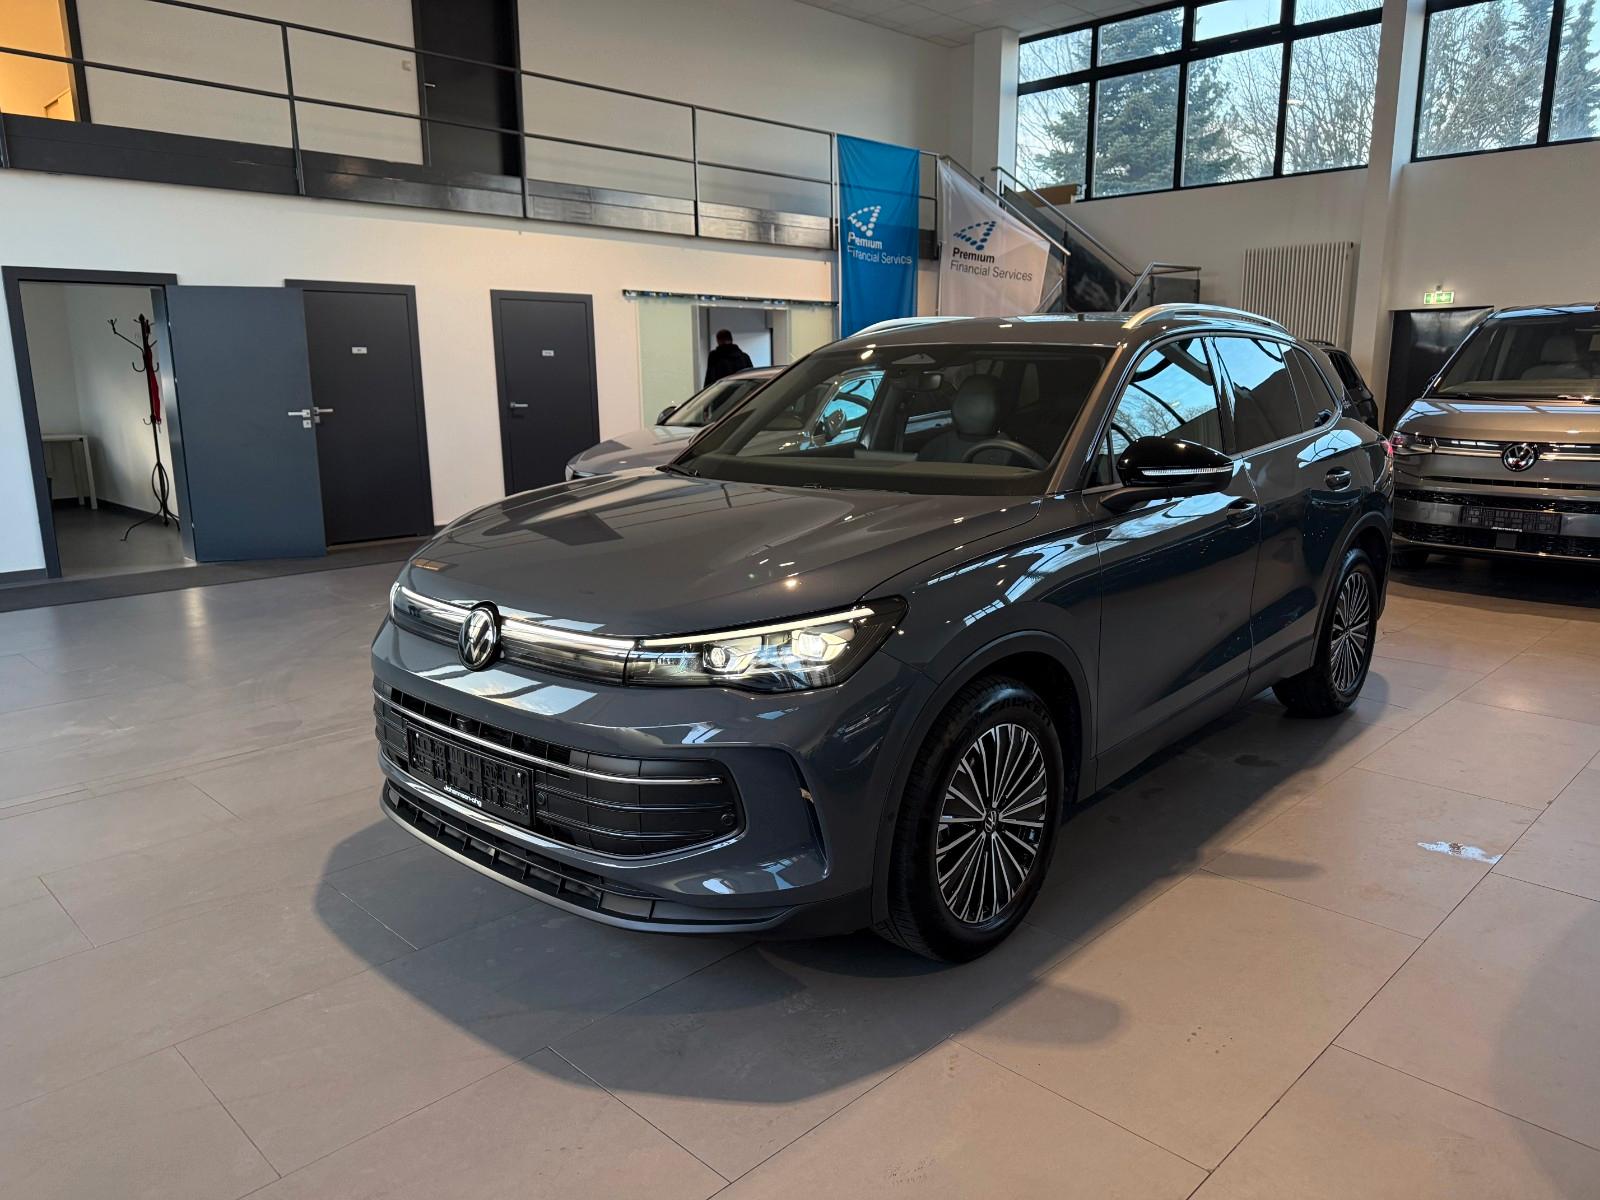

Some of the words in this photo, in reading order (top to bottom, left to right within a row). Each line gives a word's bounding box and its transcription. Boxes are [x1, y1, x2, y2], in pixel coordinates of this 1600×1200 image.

[848, 232, 882, 250] Pemium
[952, 247, 995, 263] Premium
[950, 260, 990, 276] Financial
[992, 266, 1033, 281] Services
